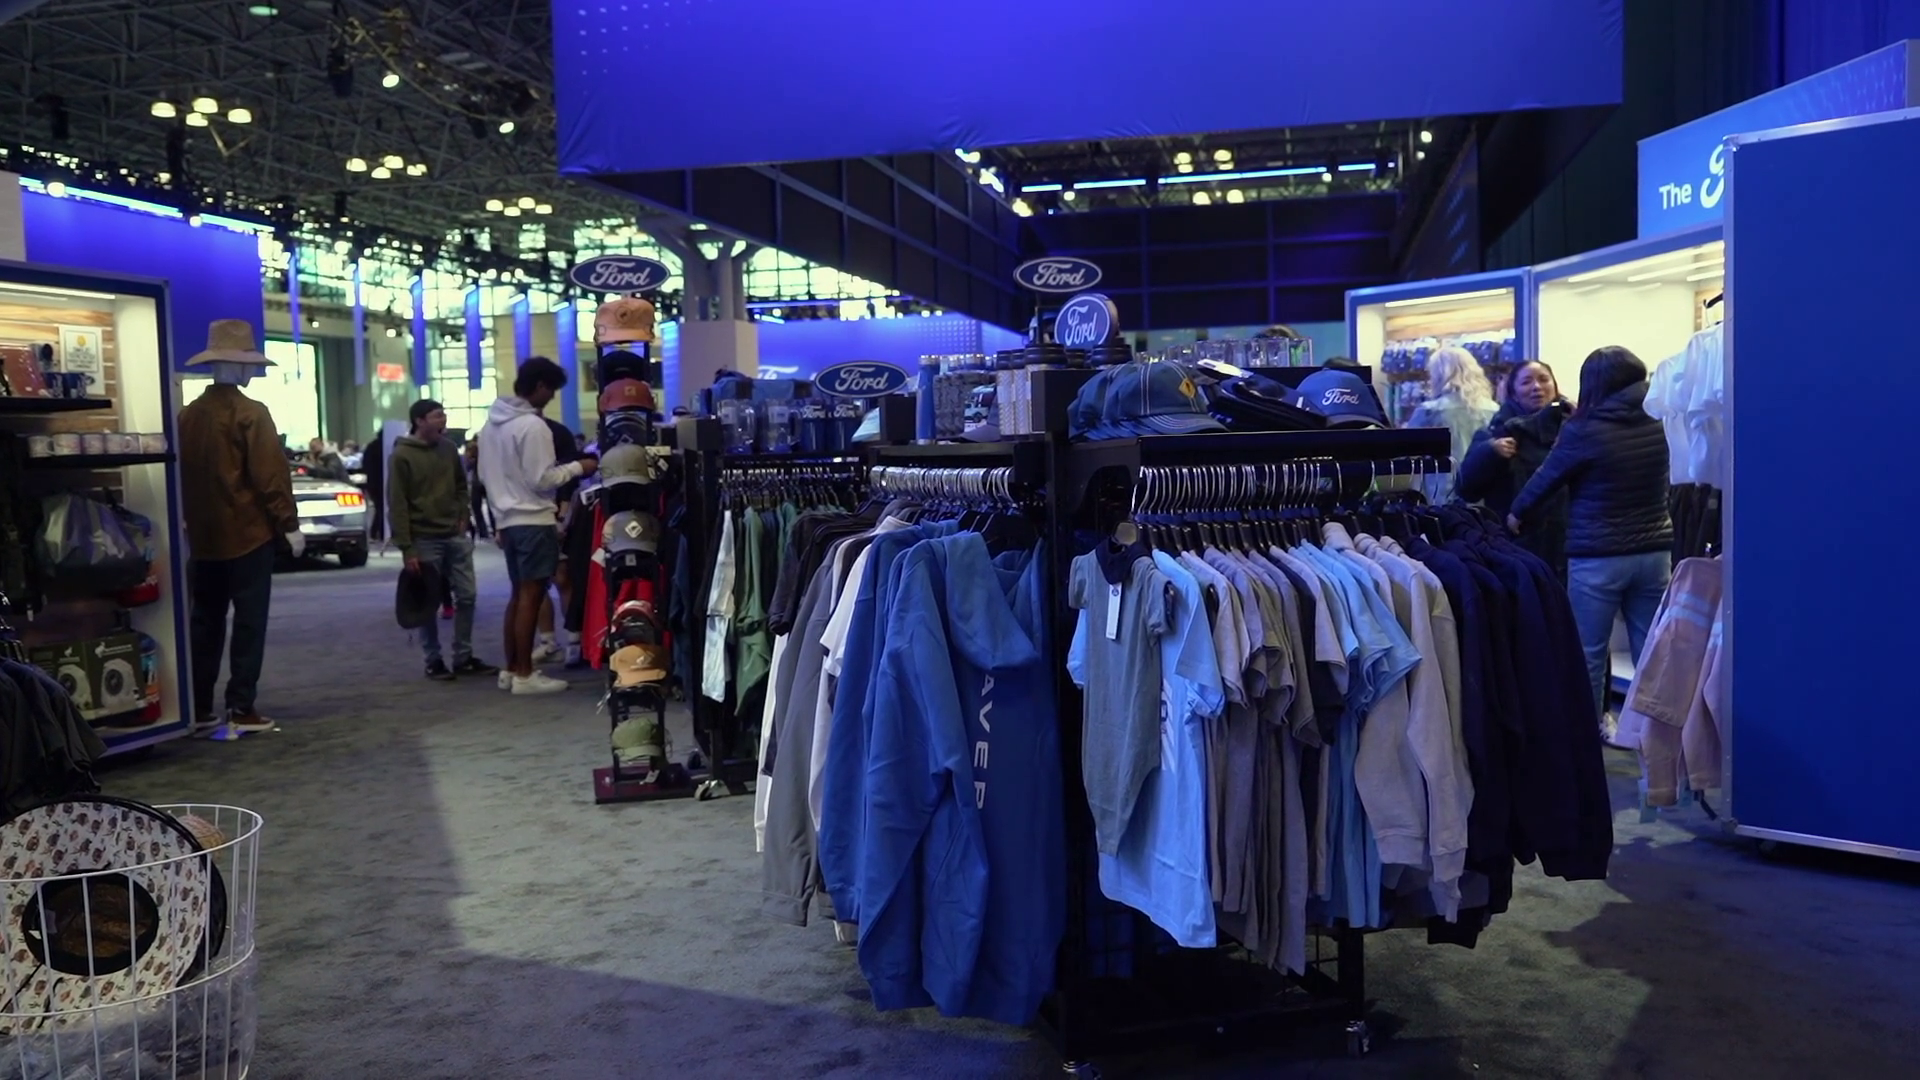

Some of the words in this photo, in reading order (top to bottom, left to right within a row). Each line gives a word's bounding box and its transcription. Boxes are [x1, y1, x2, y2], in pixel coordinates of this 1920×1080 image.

[1658, 182, 1692, 210] The
[590, 260, 651, 286] Ford
[1033, 262, 1086, 286] Ford
[1065, 305, 1098, 347] Ford
[834, 366, 889, 391] Ford
[1322, 388, 1360, 406] Ford
